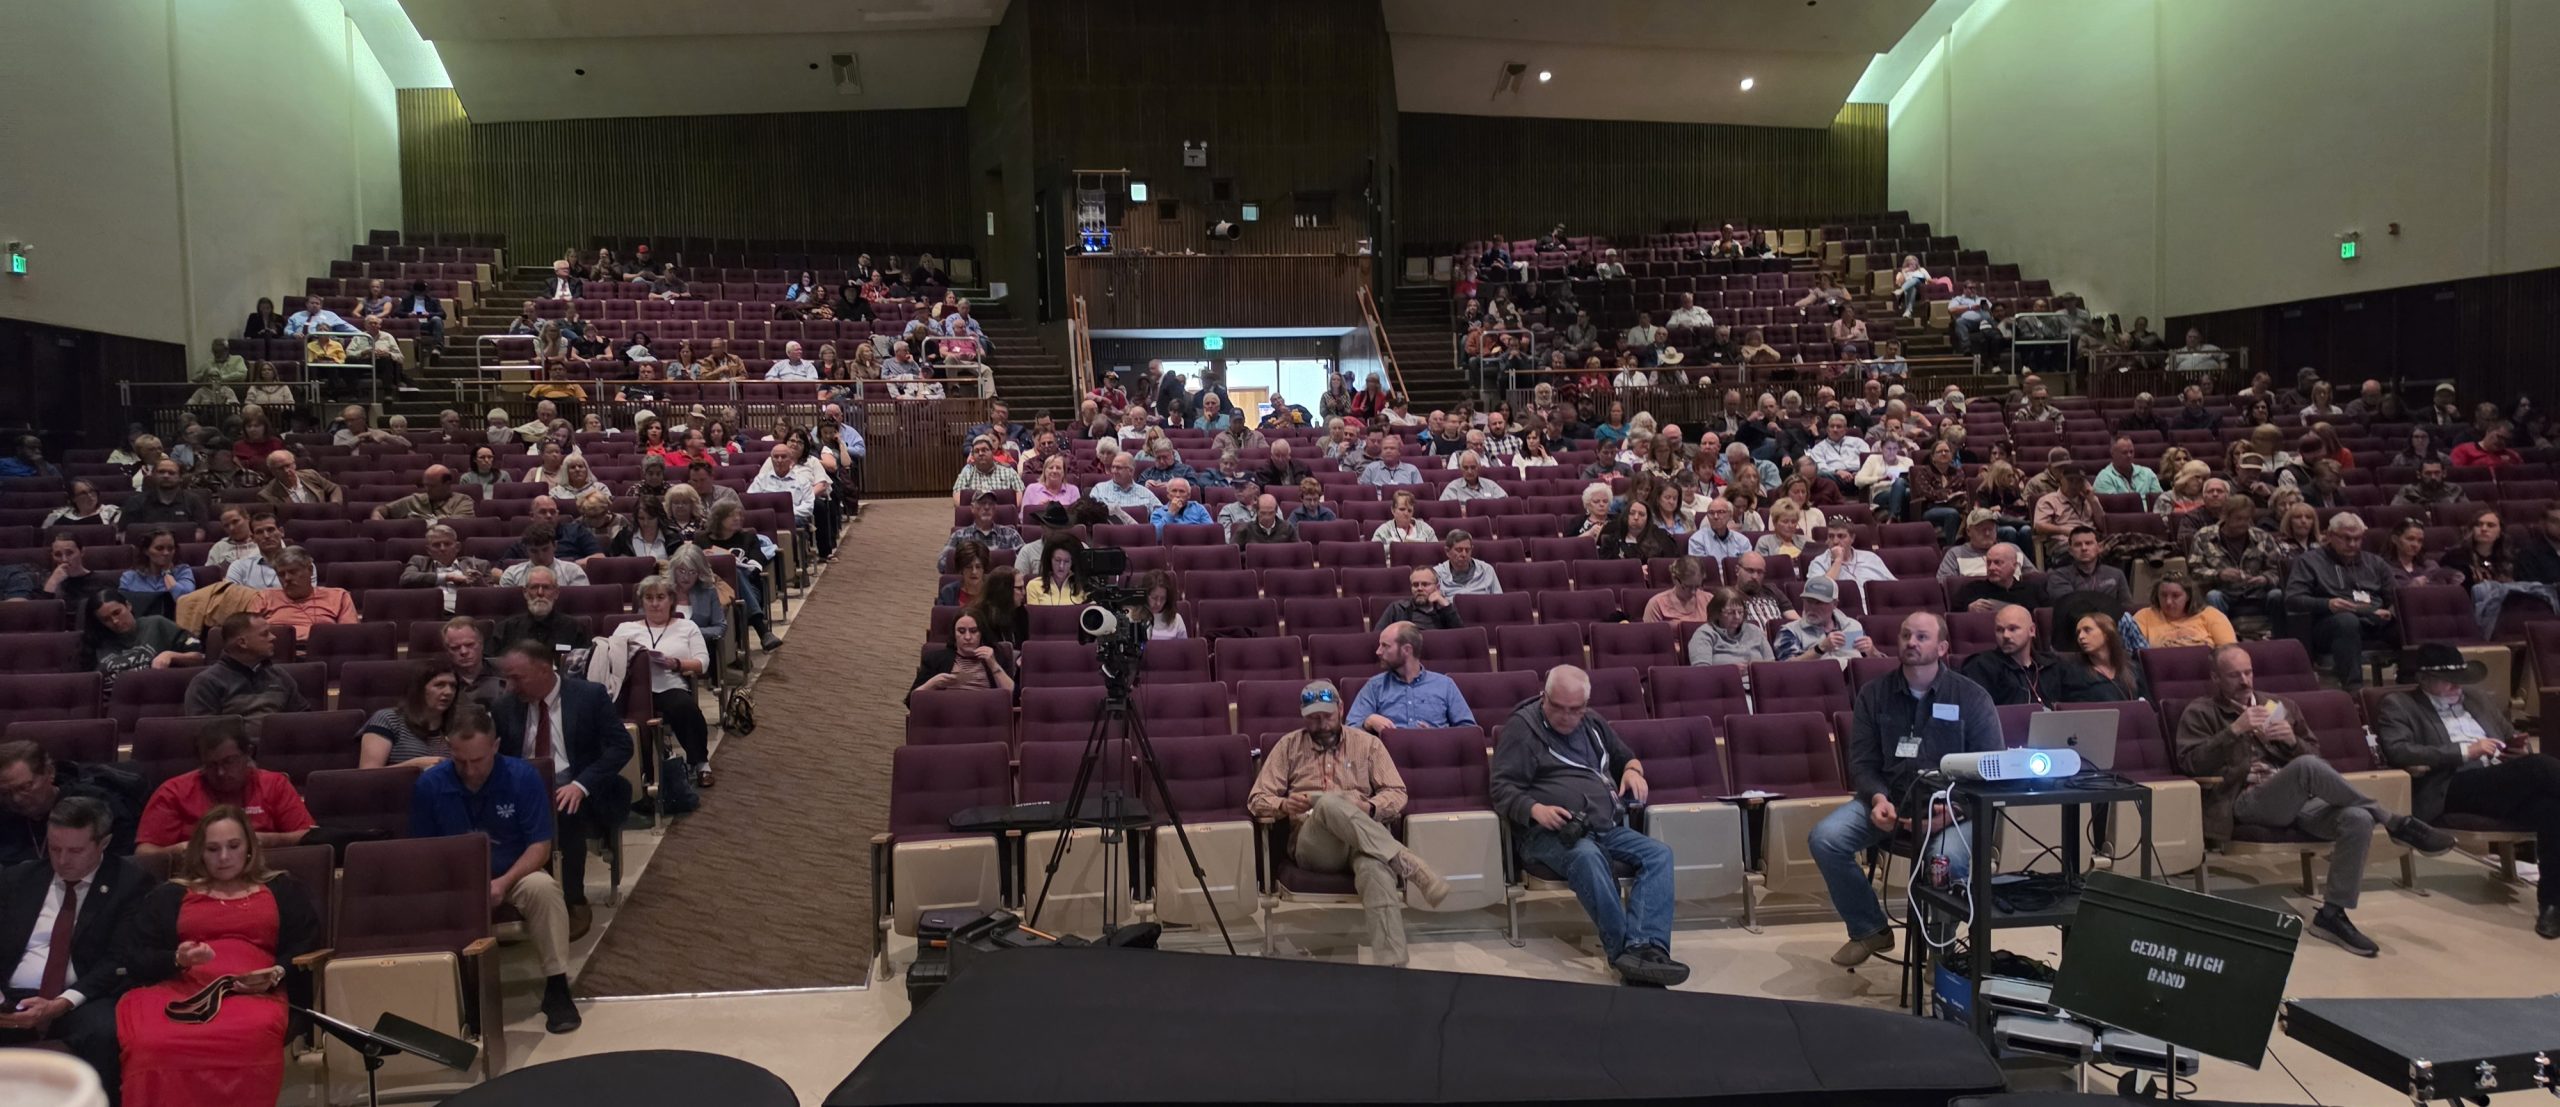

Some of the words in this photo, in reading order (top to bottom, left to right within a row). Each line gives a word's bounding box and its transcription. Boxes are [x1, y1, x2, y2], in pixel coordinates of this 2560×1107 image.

[2276, 914, 2295, 928] 17
[2130, 939, 2178, 963] CEDAR
[2184, 951, 2225, 974] HIGH
[2147, 967, 2186, 989] BAND
